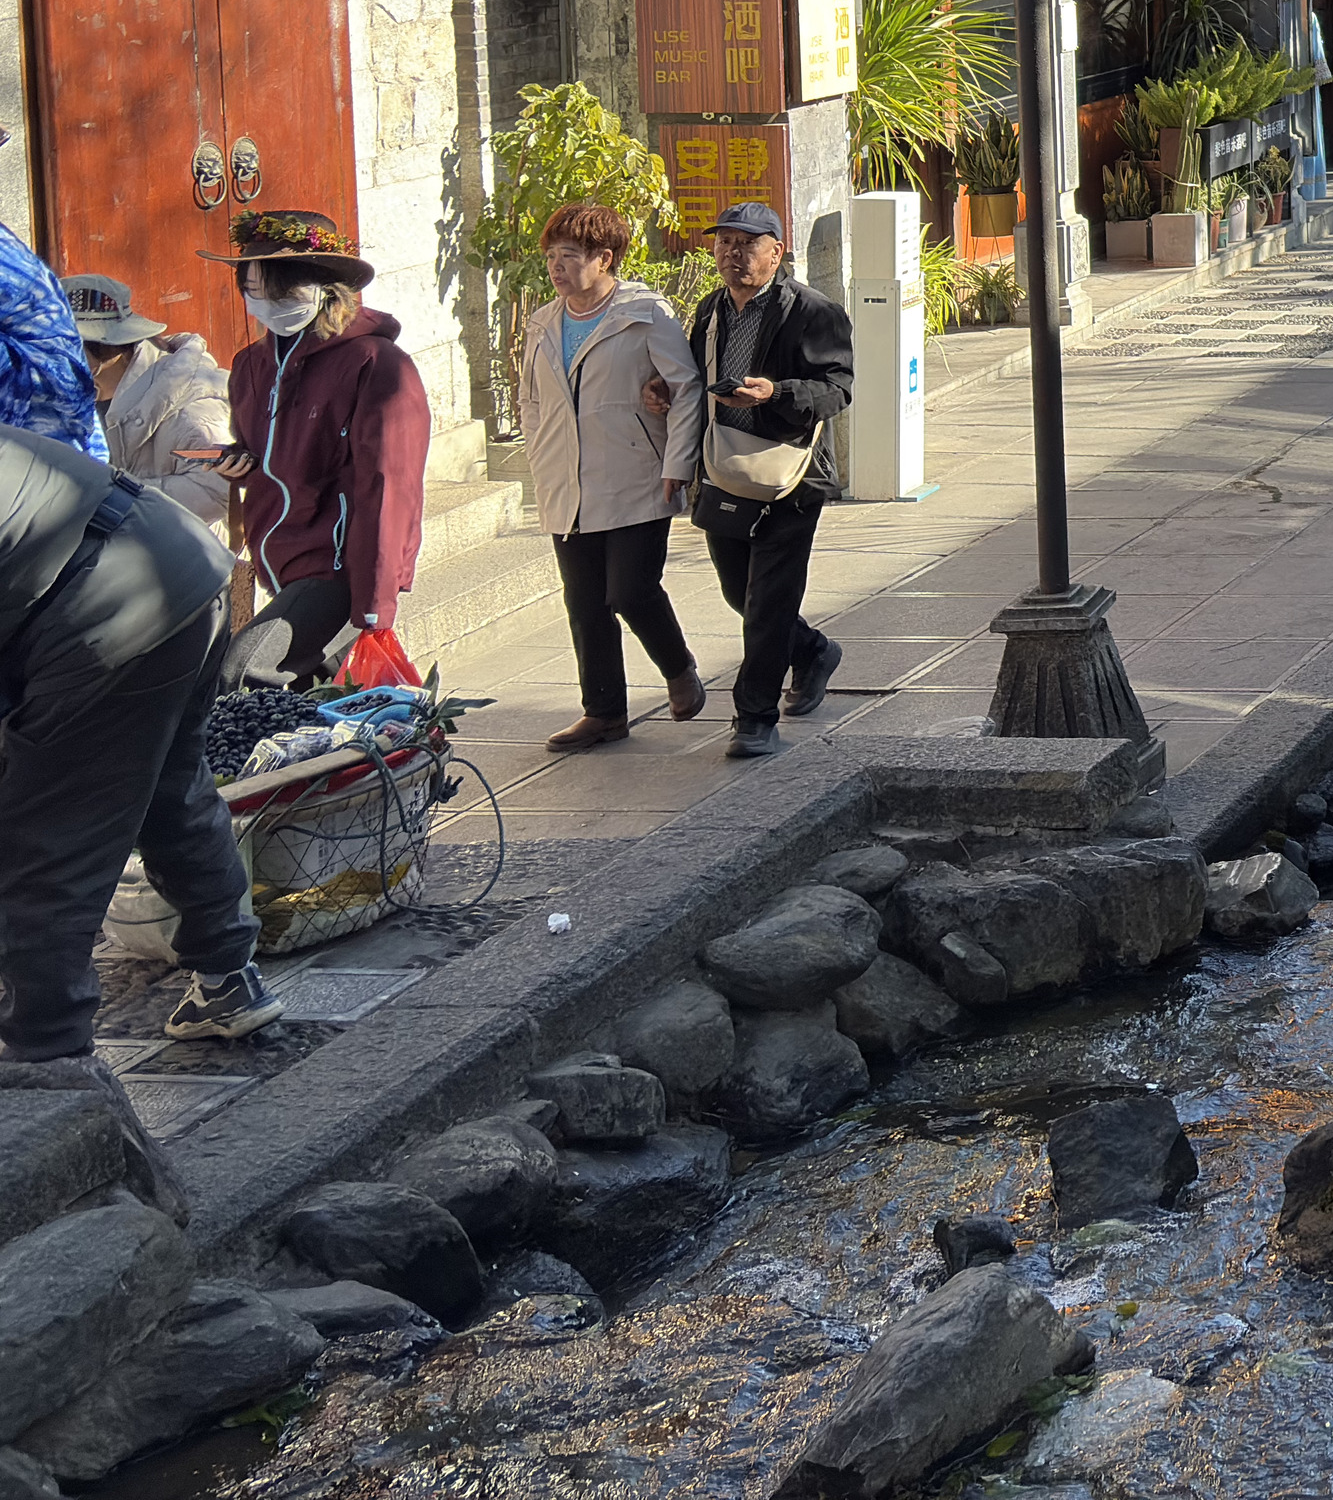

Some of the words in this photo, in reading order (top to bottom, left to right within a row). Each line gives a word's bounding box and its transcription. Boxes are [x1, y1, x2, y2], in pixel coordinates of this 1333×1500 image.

[653, 30, 690, 44] LISE
[654, 50, 708, 63] MUSIC
[655, 70, 691, 83] BAR
[676, 137, 769, 181] 安静
[679, 194, 770, 239] 民
